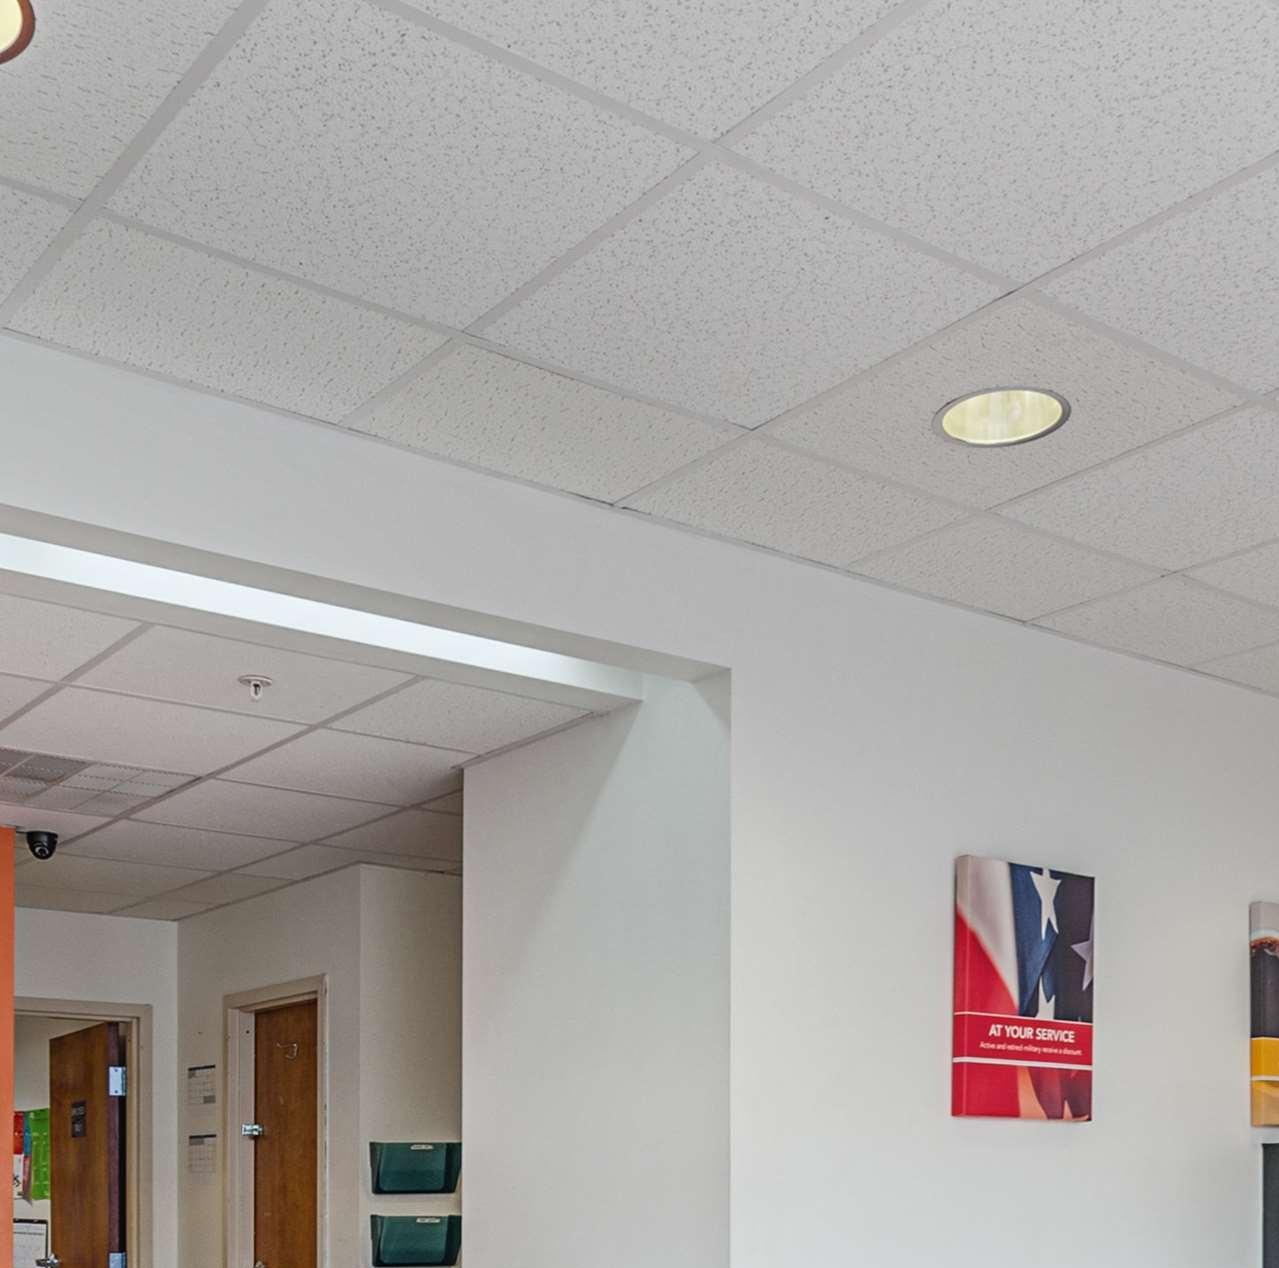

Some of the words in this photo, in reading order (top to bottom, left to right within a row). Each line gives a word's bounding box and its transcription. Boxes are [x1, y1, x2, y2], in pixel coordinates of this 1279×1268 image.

[988, 1024, 1003, 1036] AT
[1004, 1025, 1034, 1040] YOUR
[1035, 1027, 1076, 1043] SERVICE
